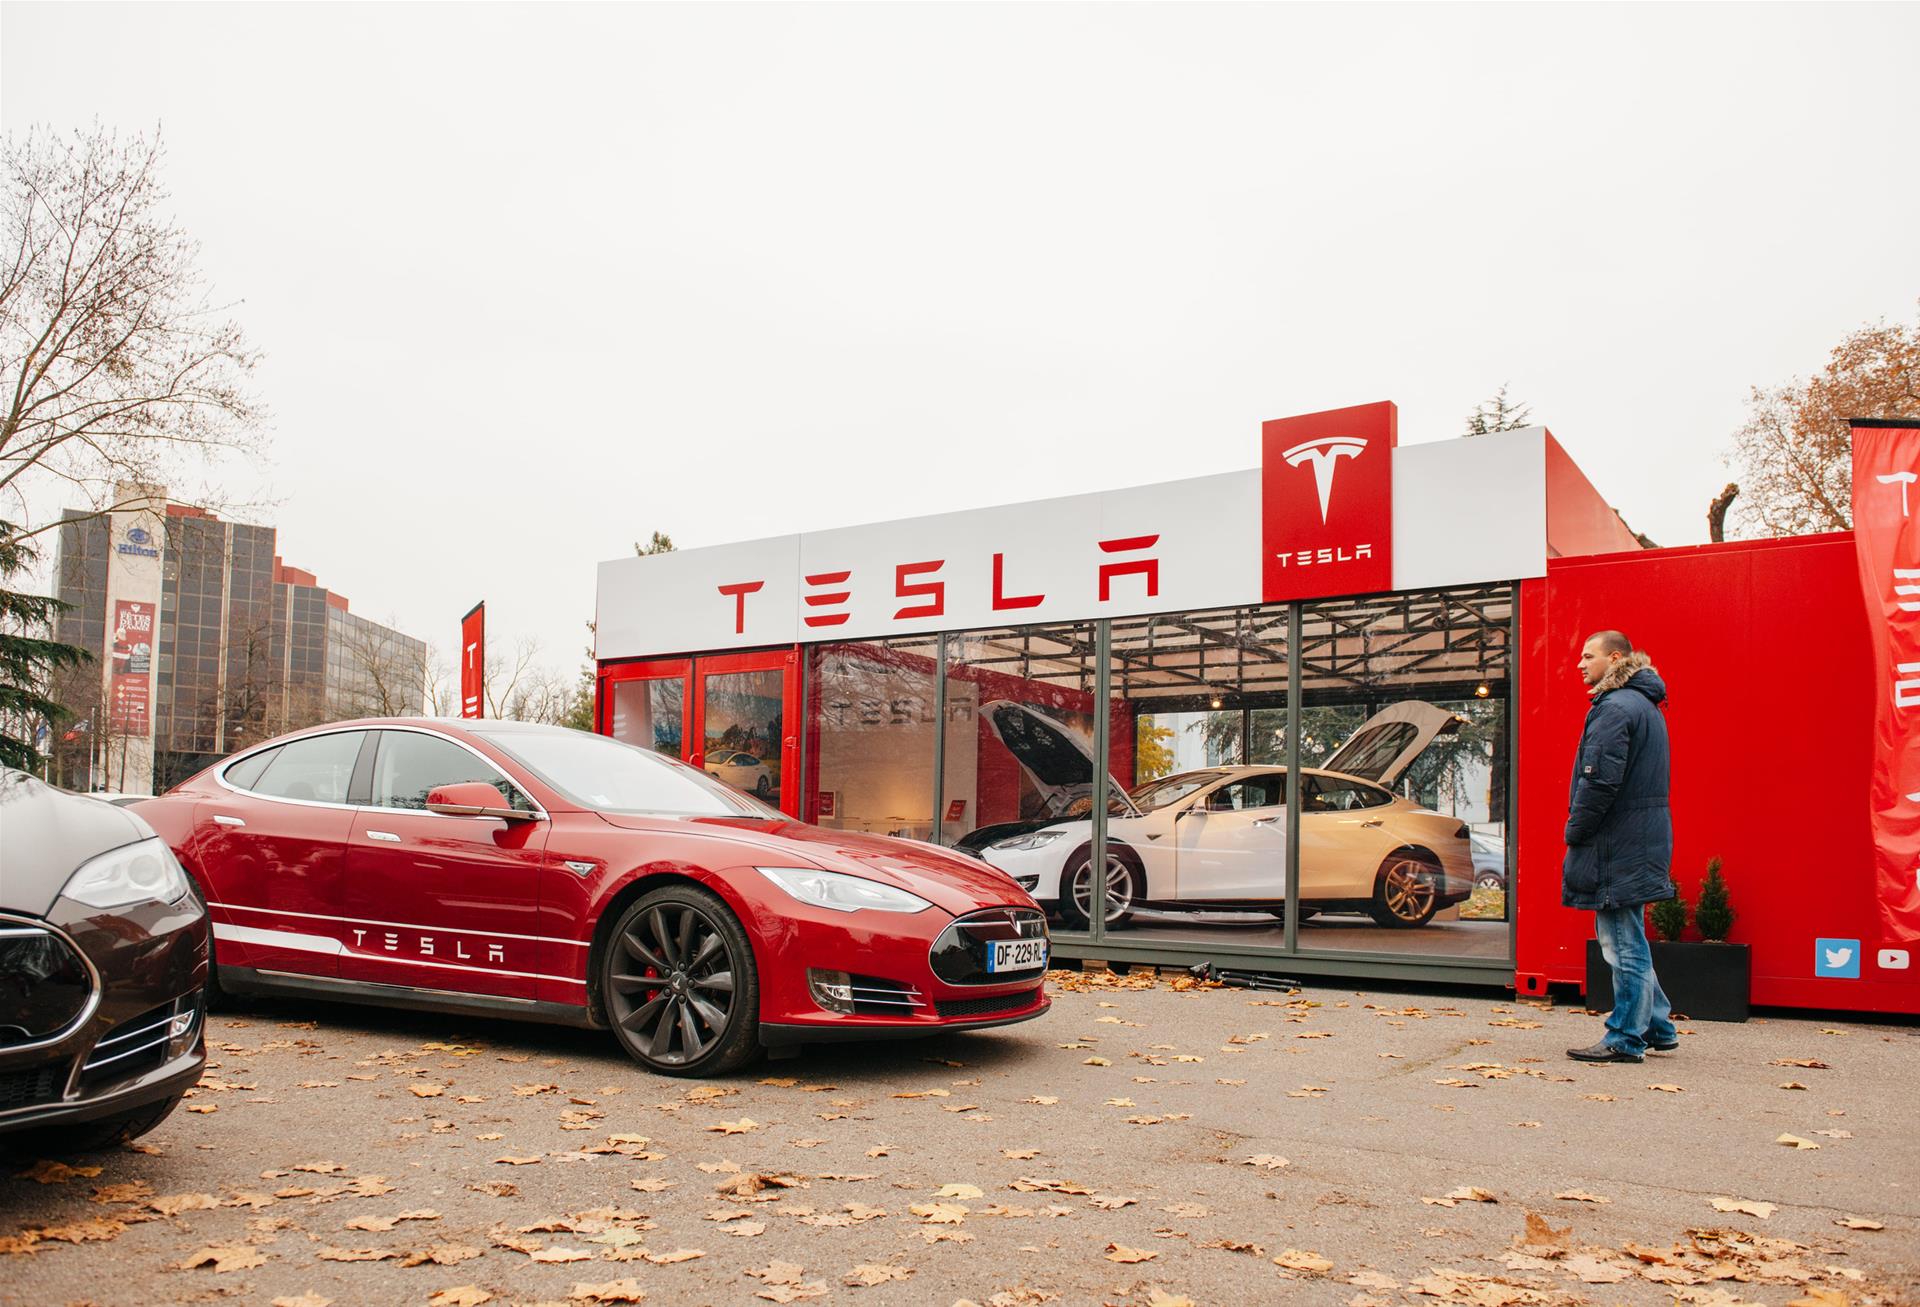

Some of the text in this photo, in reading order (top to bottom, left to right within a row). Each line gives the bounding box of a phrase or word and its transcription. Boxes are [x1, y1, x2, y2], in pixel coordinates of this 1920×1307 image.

[118, 543, 158, 557] Hilton
[1276, 543, 1372, 568] TESLA
[718, 534, 1158, 633] TESLA
[353, 929, 504, 963] TESLA
